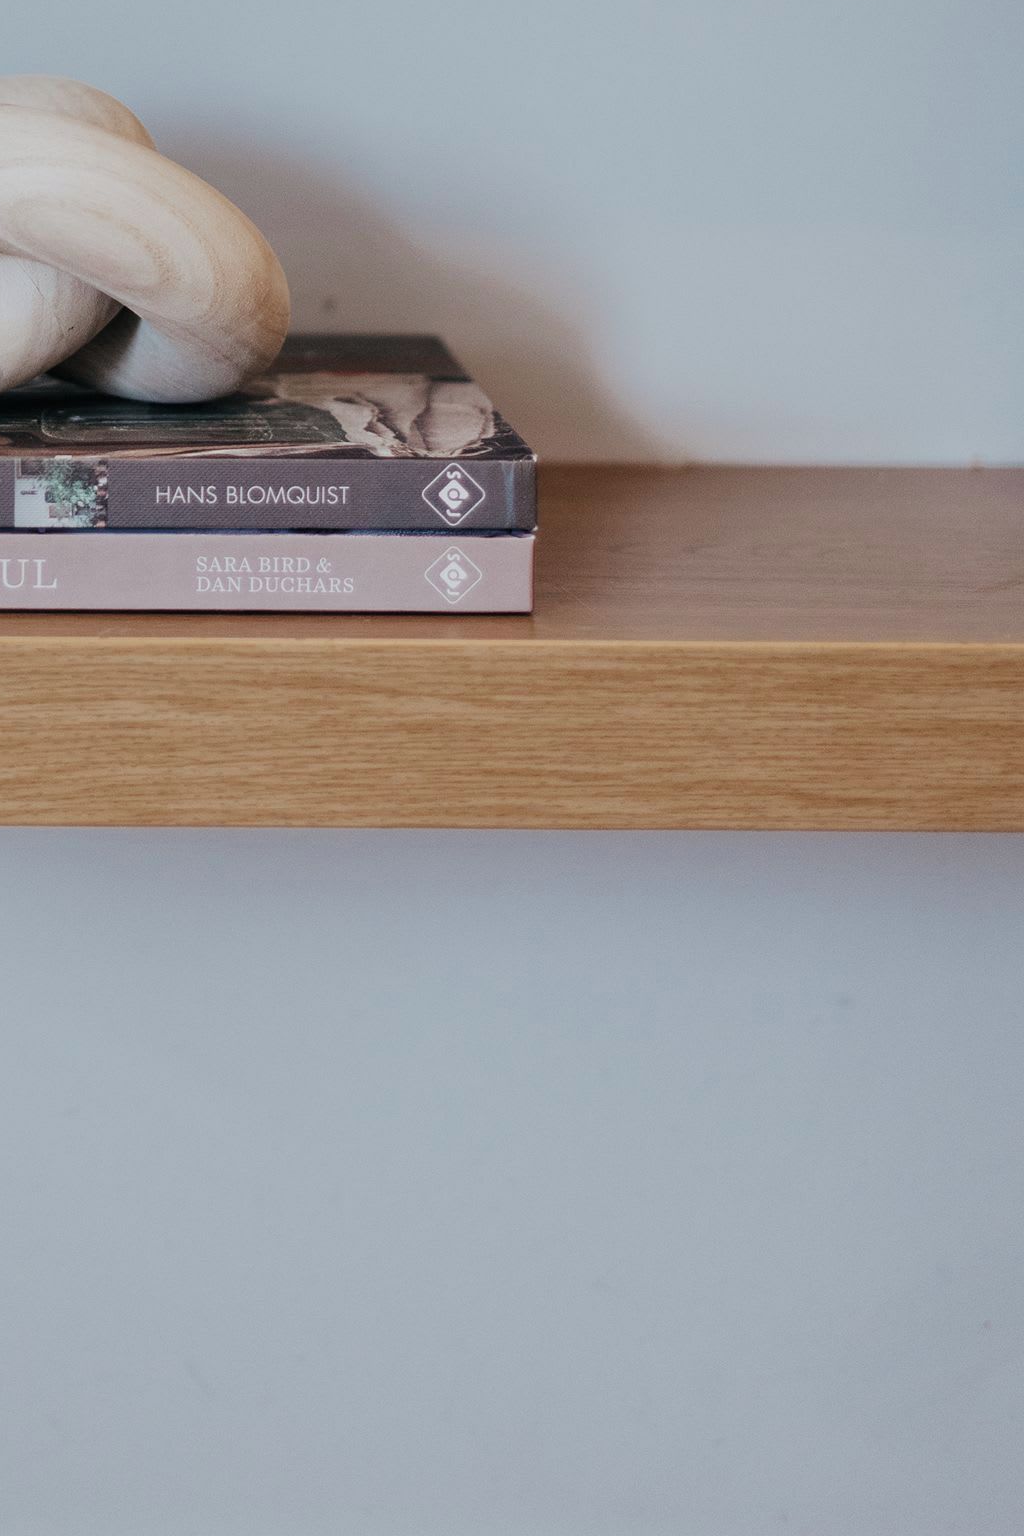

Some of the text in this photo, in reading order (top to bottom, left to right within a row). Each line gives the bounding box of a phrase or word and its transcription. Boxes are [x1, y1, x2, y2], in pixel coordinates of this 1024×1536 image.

[155, 485, 350, 506] HANS BLOMQUIST
[195, 556, 332, 574] SARA BIRD &
[195, 576, 354, 594] DAN DUCHARS
